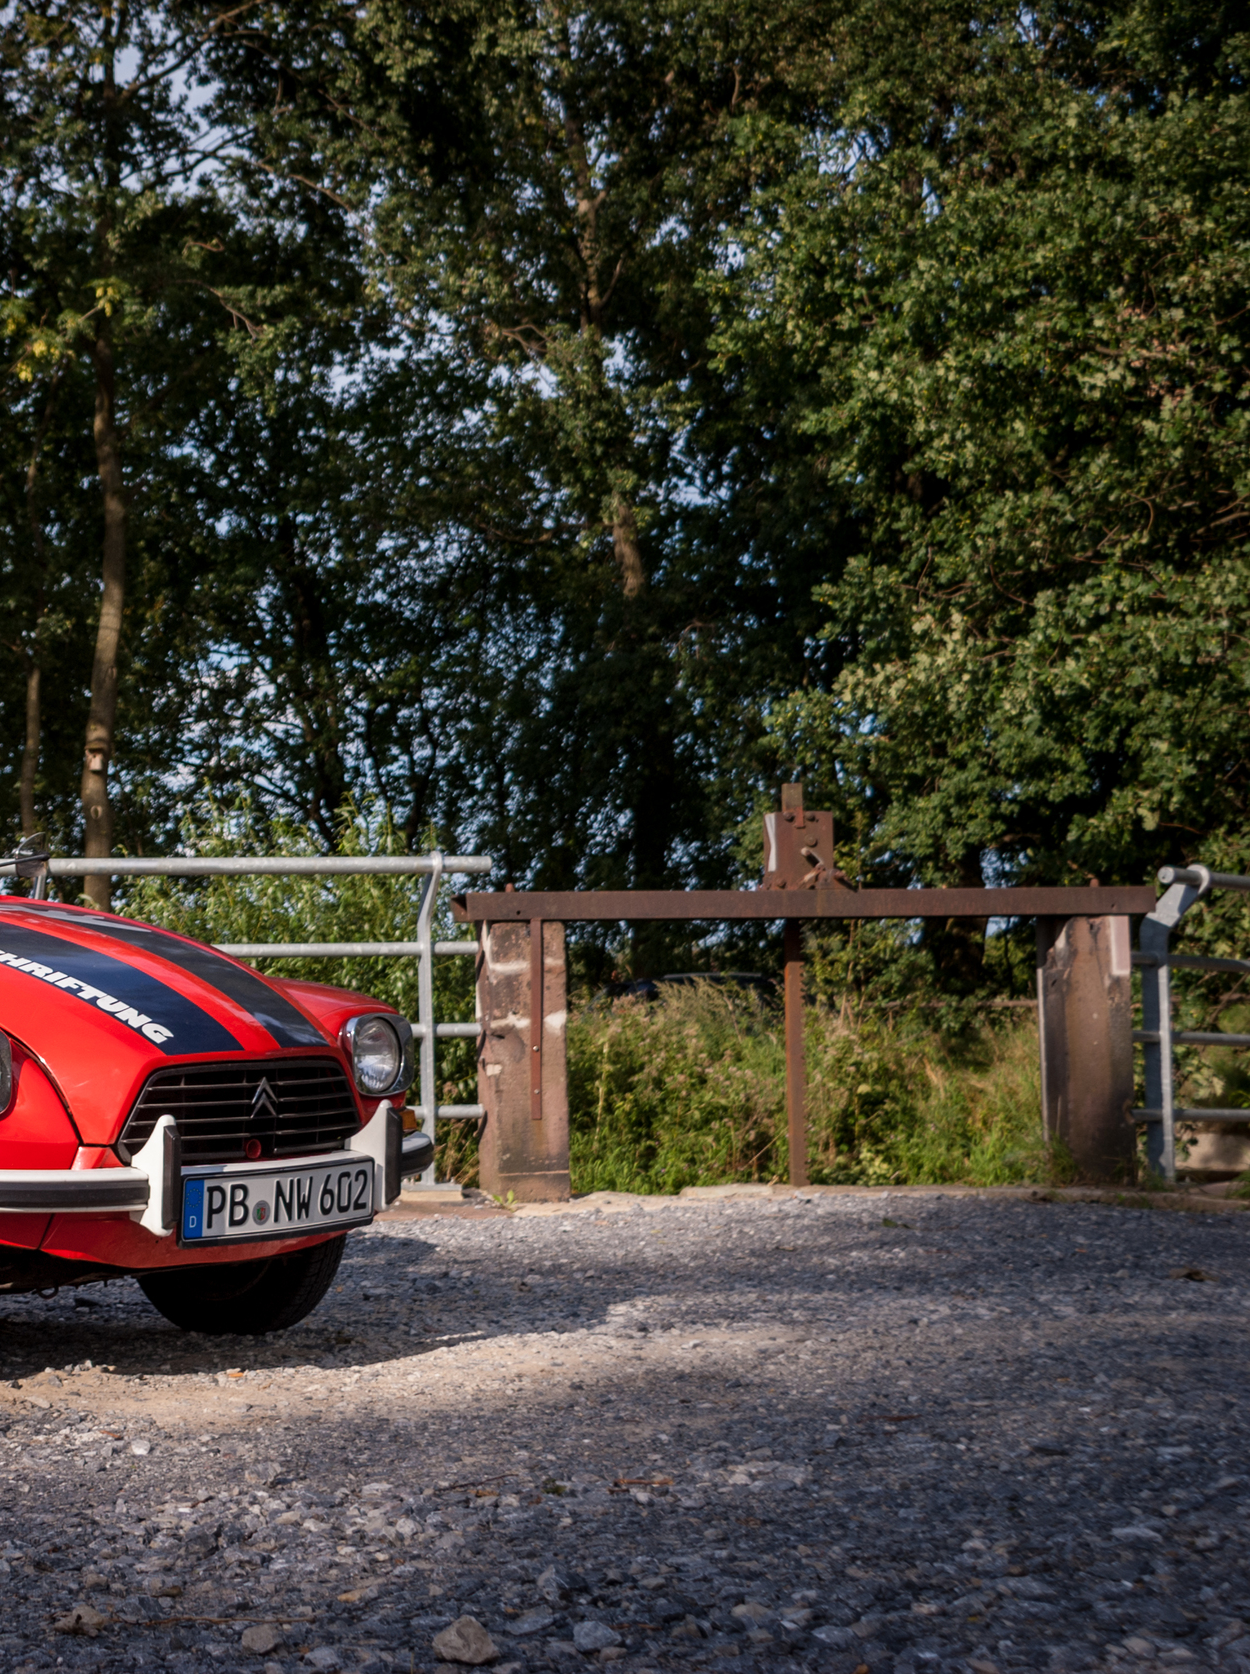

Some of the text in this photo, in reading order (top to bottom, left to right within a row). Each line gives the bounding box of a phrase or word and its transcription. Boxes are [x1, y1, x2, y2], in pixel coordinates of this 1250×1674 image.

[206, 1169, 368, 1229] PB NW 602
[189, 1215, 197, 1228] D
